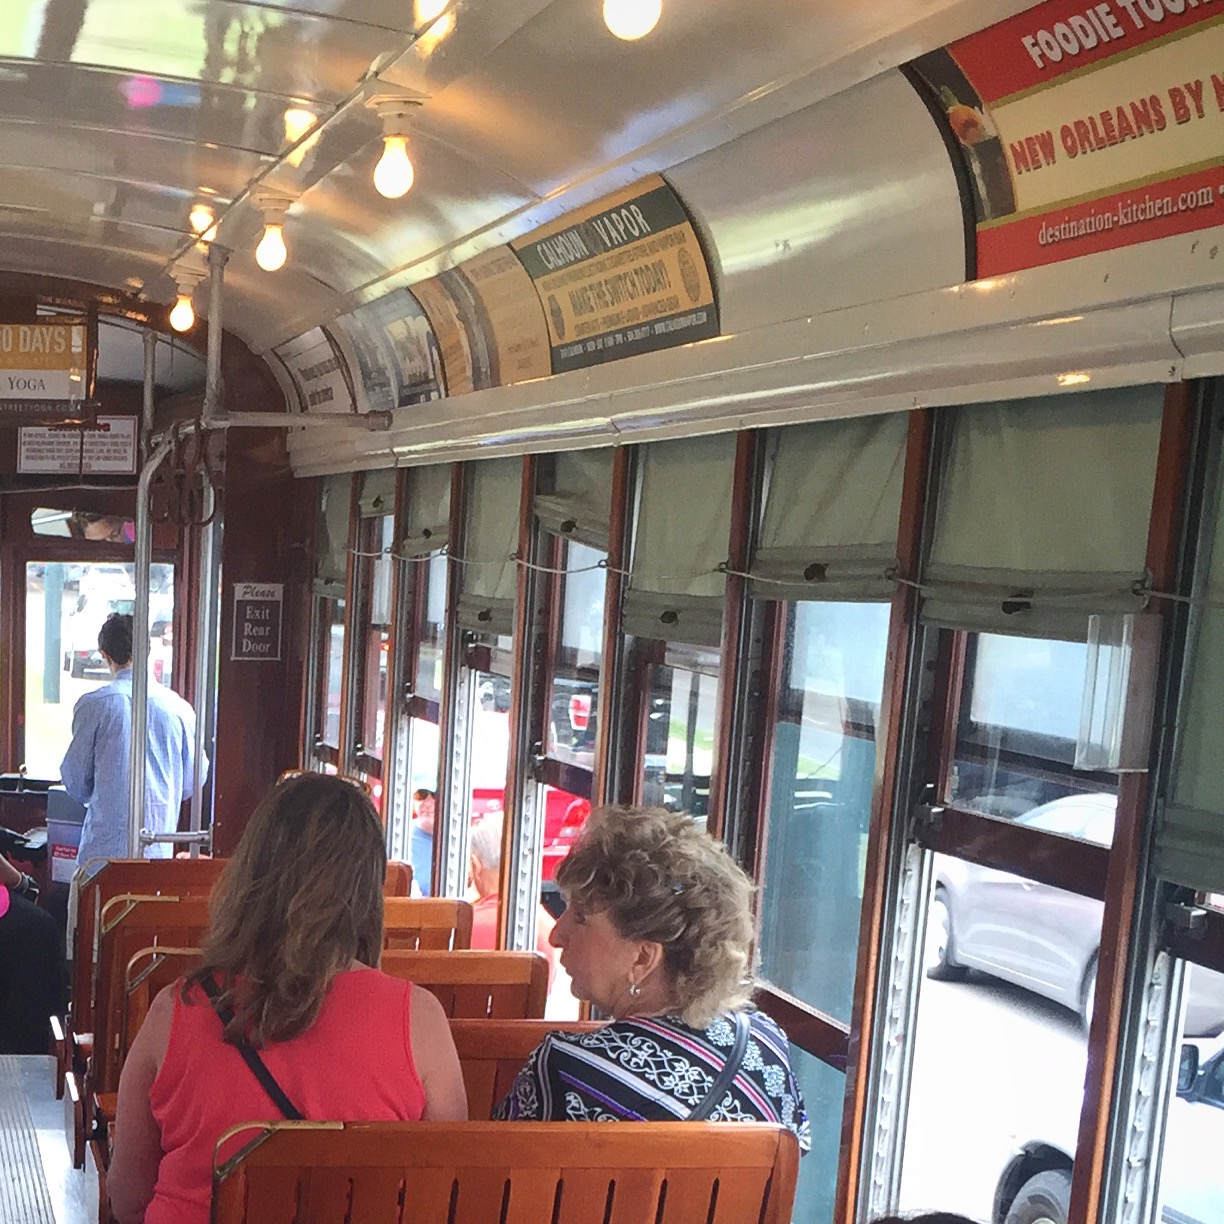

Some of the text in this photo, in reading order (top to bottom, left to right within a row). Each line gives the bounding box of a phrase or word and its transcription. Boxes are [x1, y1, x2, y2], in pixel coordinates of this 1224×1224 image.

[1021, 2, 1125, 69] FOODIE
[1009, 130, 1056, 174] NEW
[1060, 94, 1167, 158] ORLEANS
[1168, 79, 1205, 124] BY
[1038, 186, 1215, 246] destination-kitchen.com
[536, 230, 590, 270] CALHOUN
[592, 204, 652, 248] VAPOR
[604, 270, 640, 307] SWITCH
[19, 326, 66, 353] DAYS
[7, 376, 47, 392] YOGA
[242, 585, 277, 599] Please
[245, 605, 271, 620] Exit
[243, 622, 272, 637] Rear
[242, 638, 272, 653] Door
